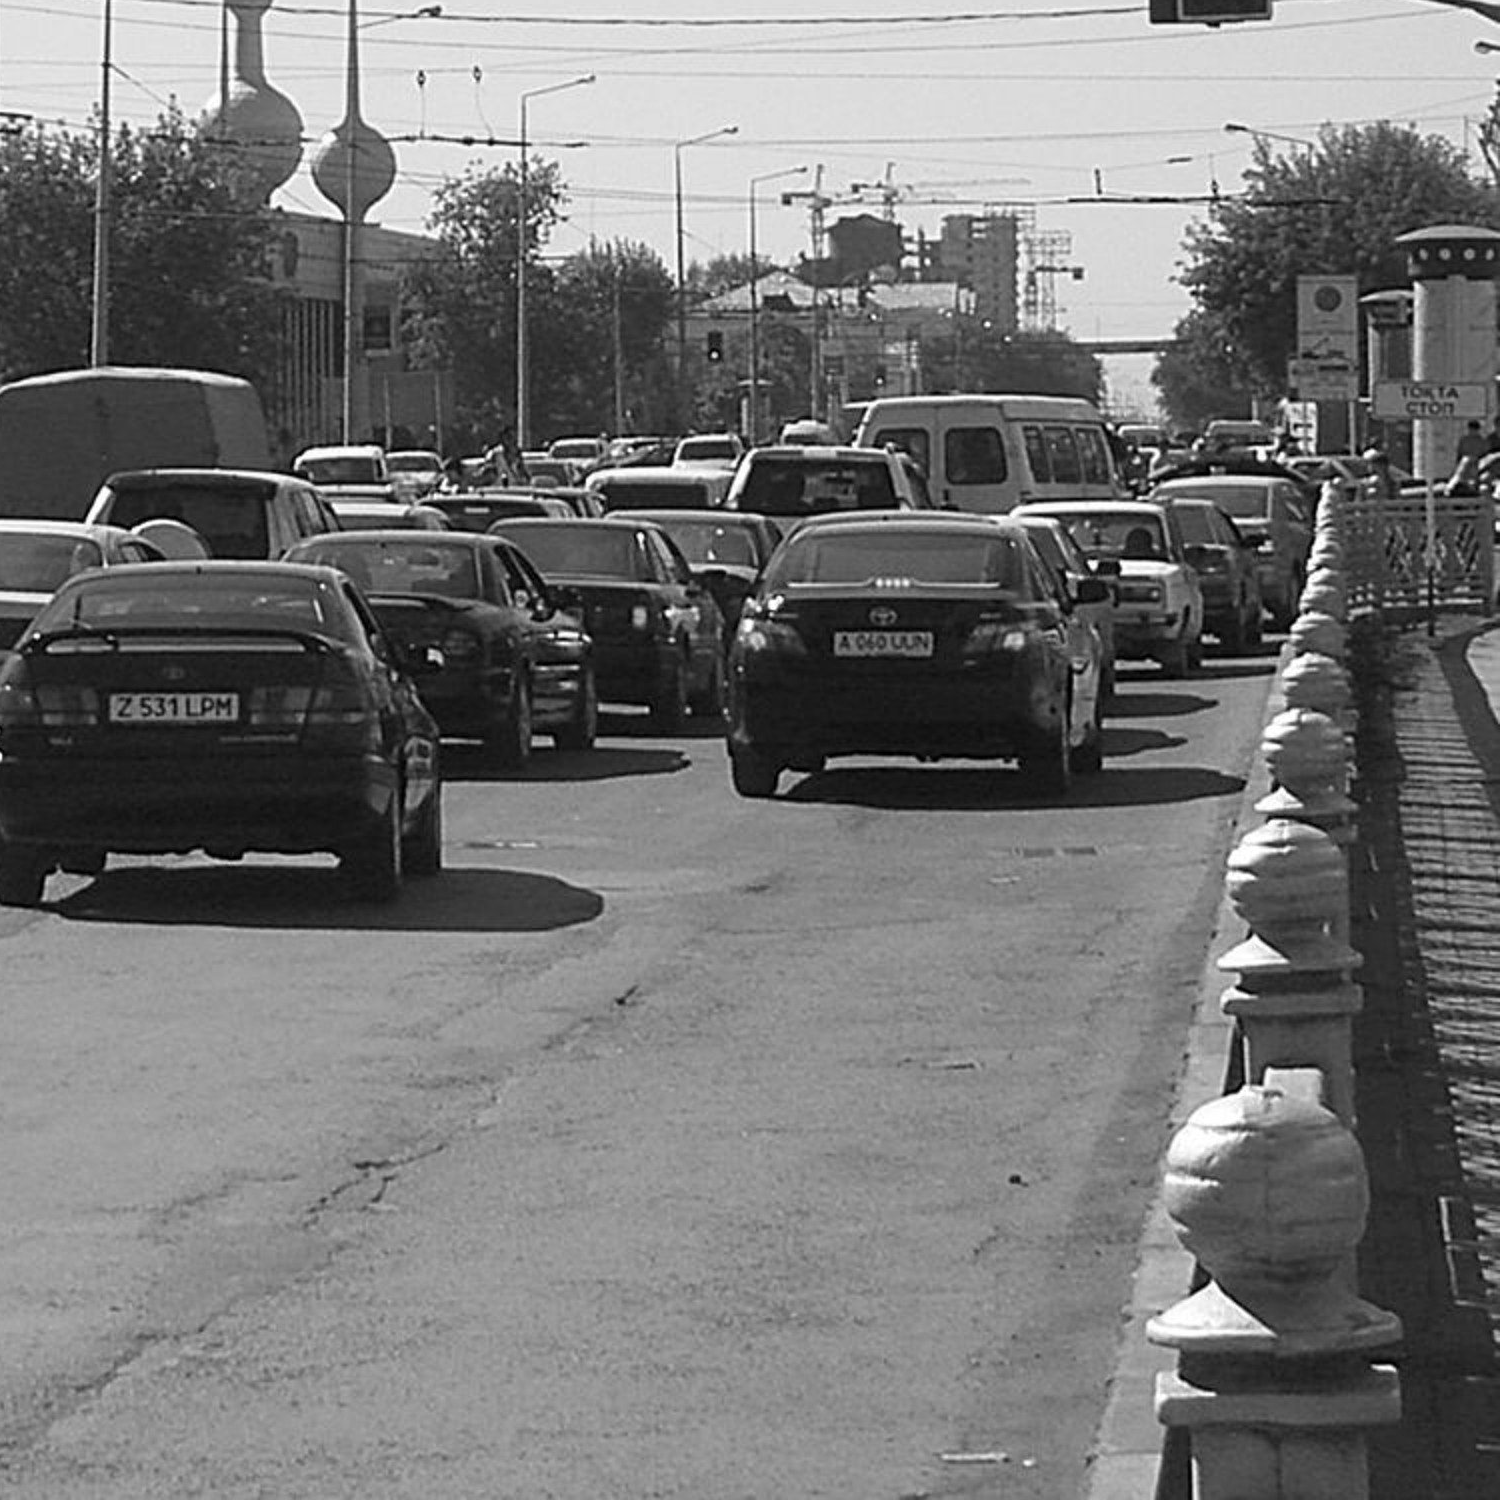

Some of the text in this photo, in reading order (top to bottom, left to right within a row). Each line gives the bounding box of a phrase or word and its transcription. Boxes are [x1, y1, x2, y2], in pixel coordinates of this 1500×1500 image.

[1400, 385, 1460, 401] ТОҚТА
[1405, 401, 1455, 415] СТОП
[838, 635, 851, 652] A
[117, 697, 232, 717] Z 531 LPM
